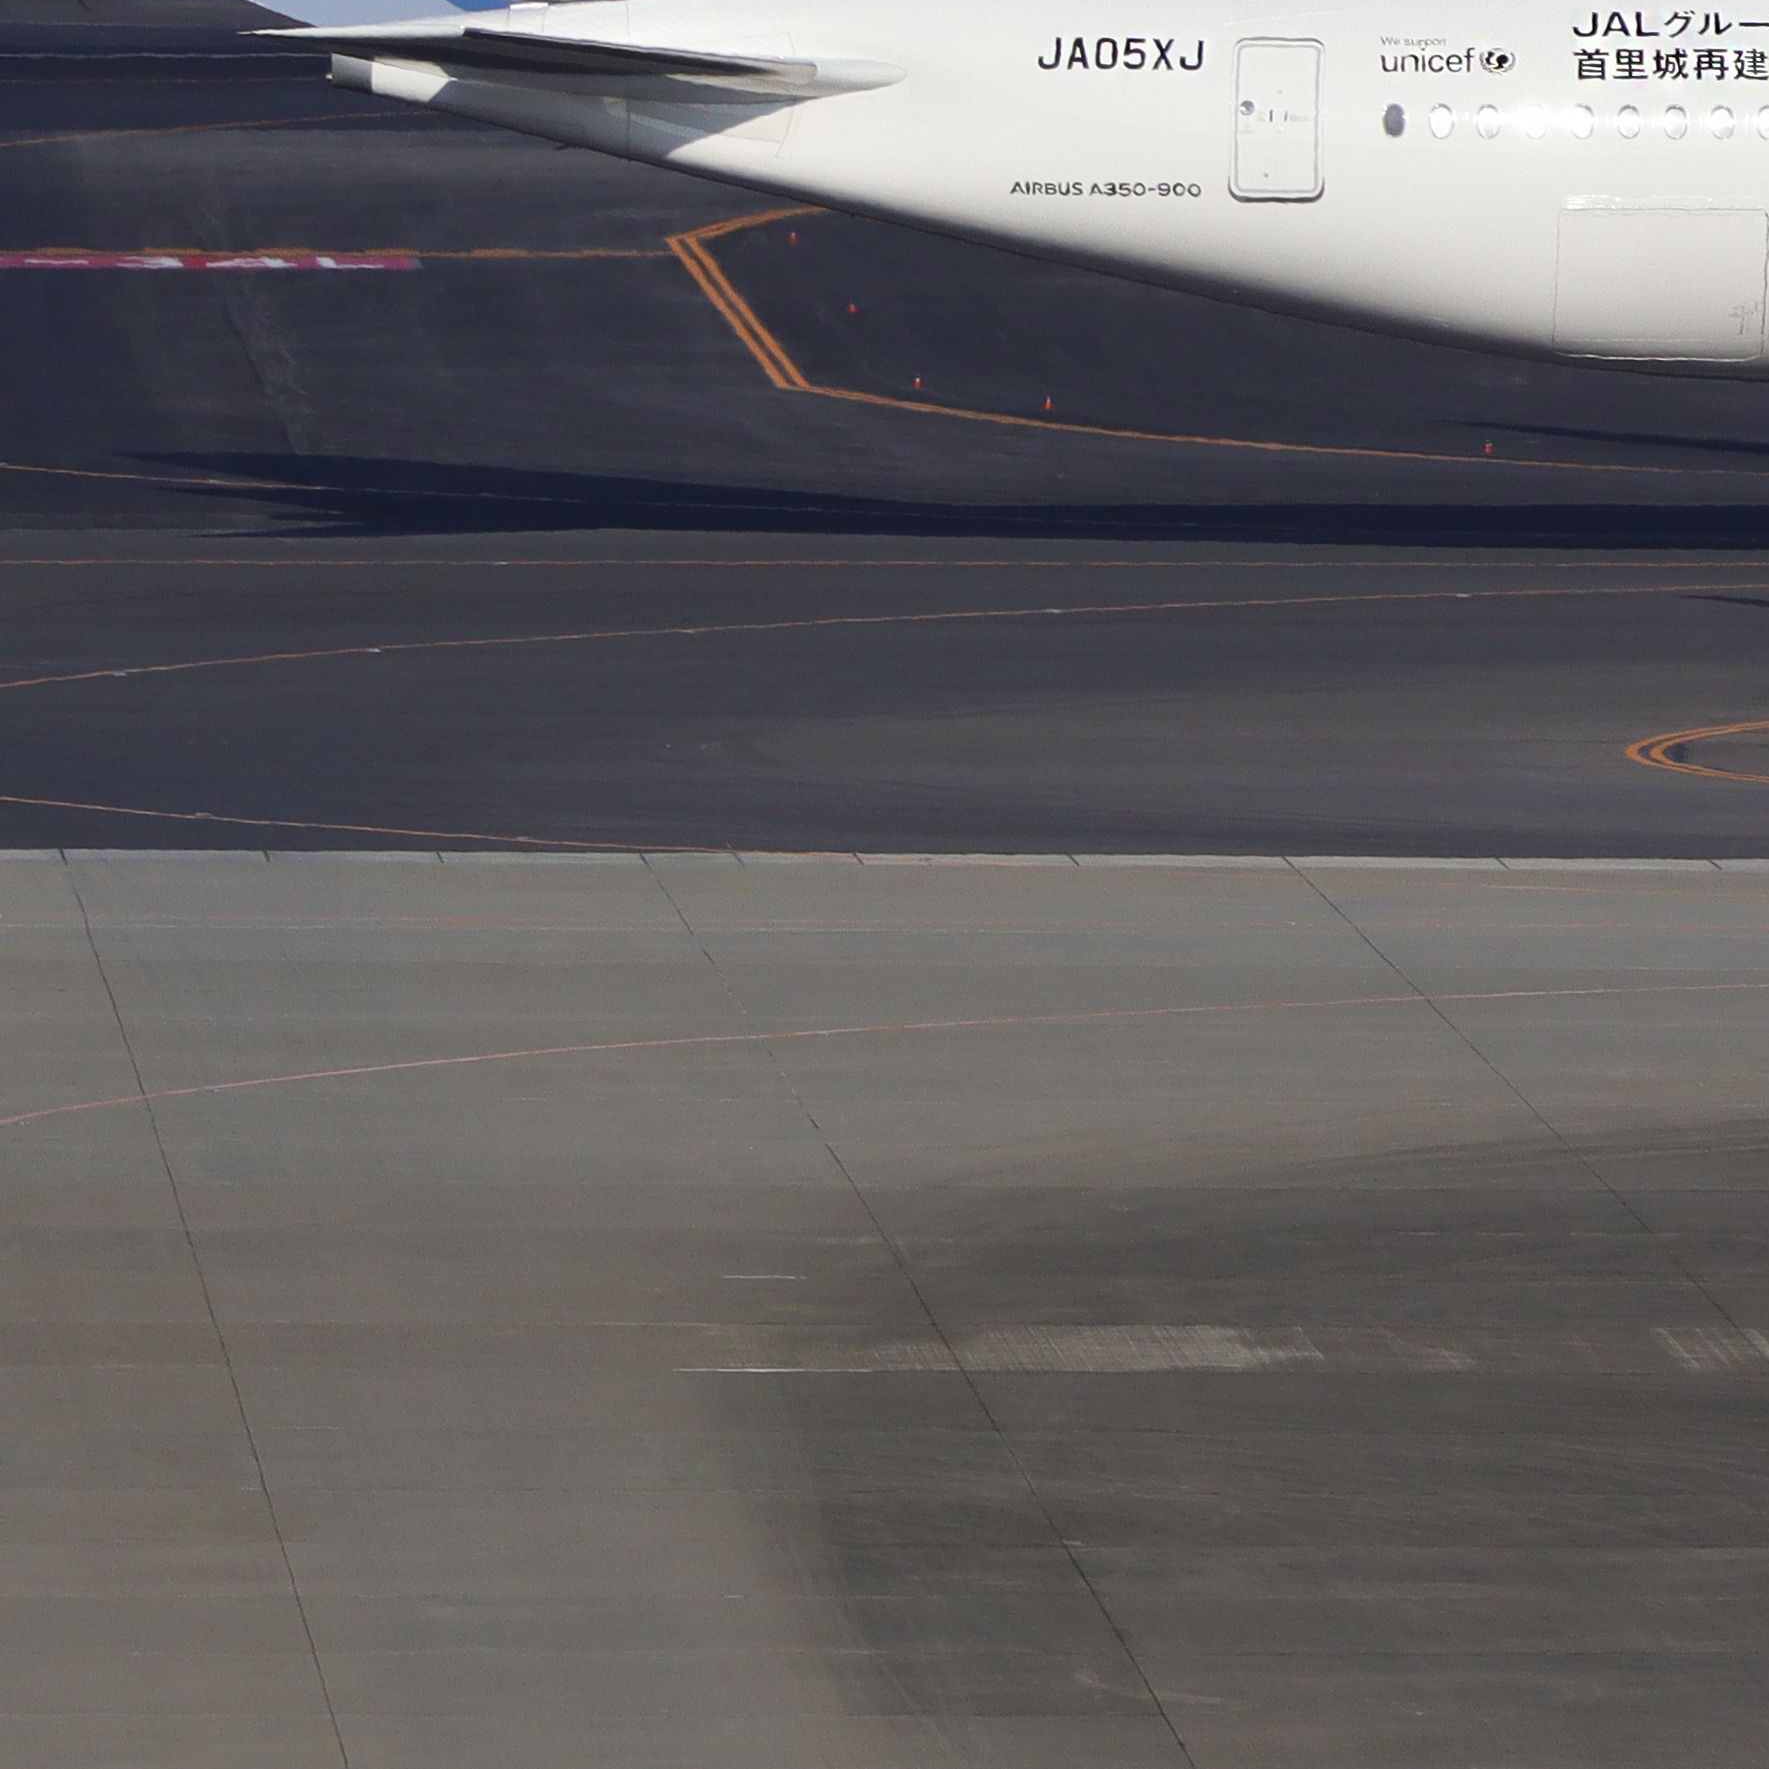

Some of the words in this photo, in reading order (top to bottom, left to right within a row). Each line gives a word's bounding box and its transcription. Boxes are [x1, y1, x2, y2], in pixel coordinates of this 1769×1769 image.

[1037, 36, 1204, 72] JA05XJ
[1380, 47, 1475, 73] unicef
[1010, 181, 1084, 198] AIRBUS
[1090, 181, 1202, 198] A350-900
